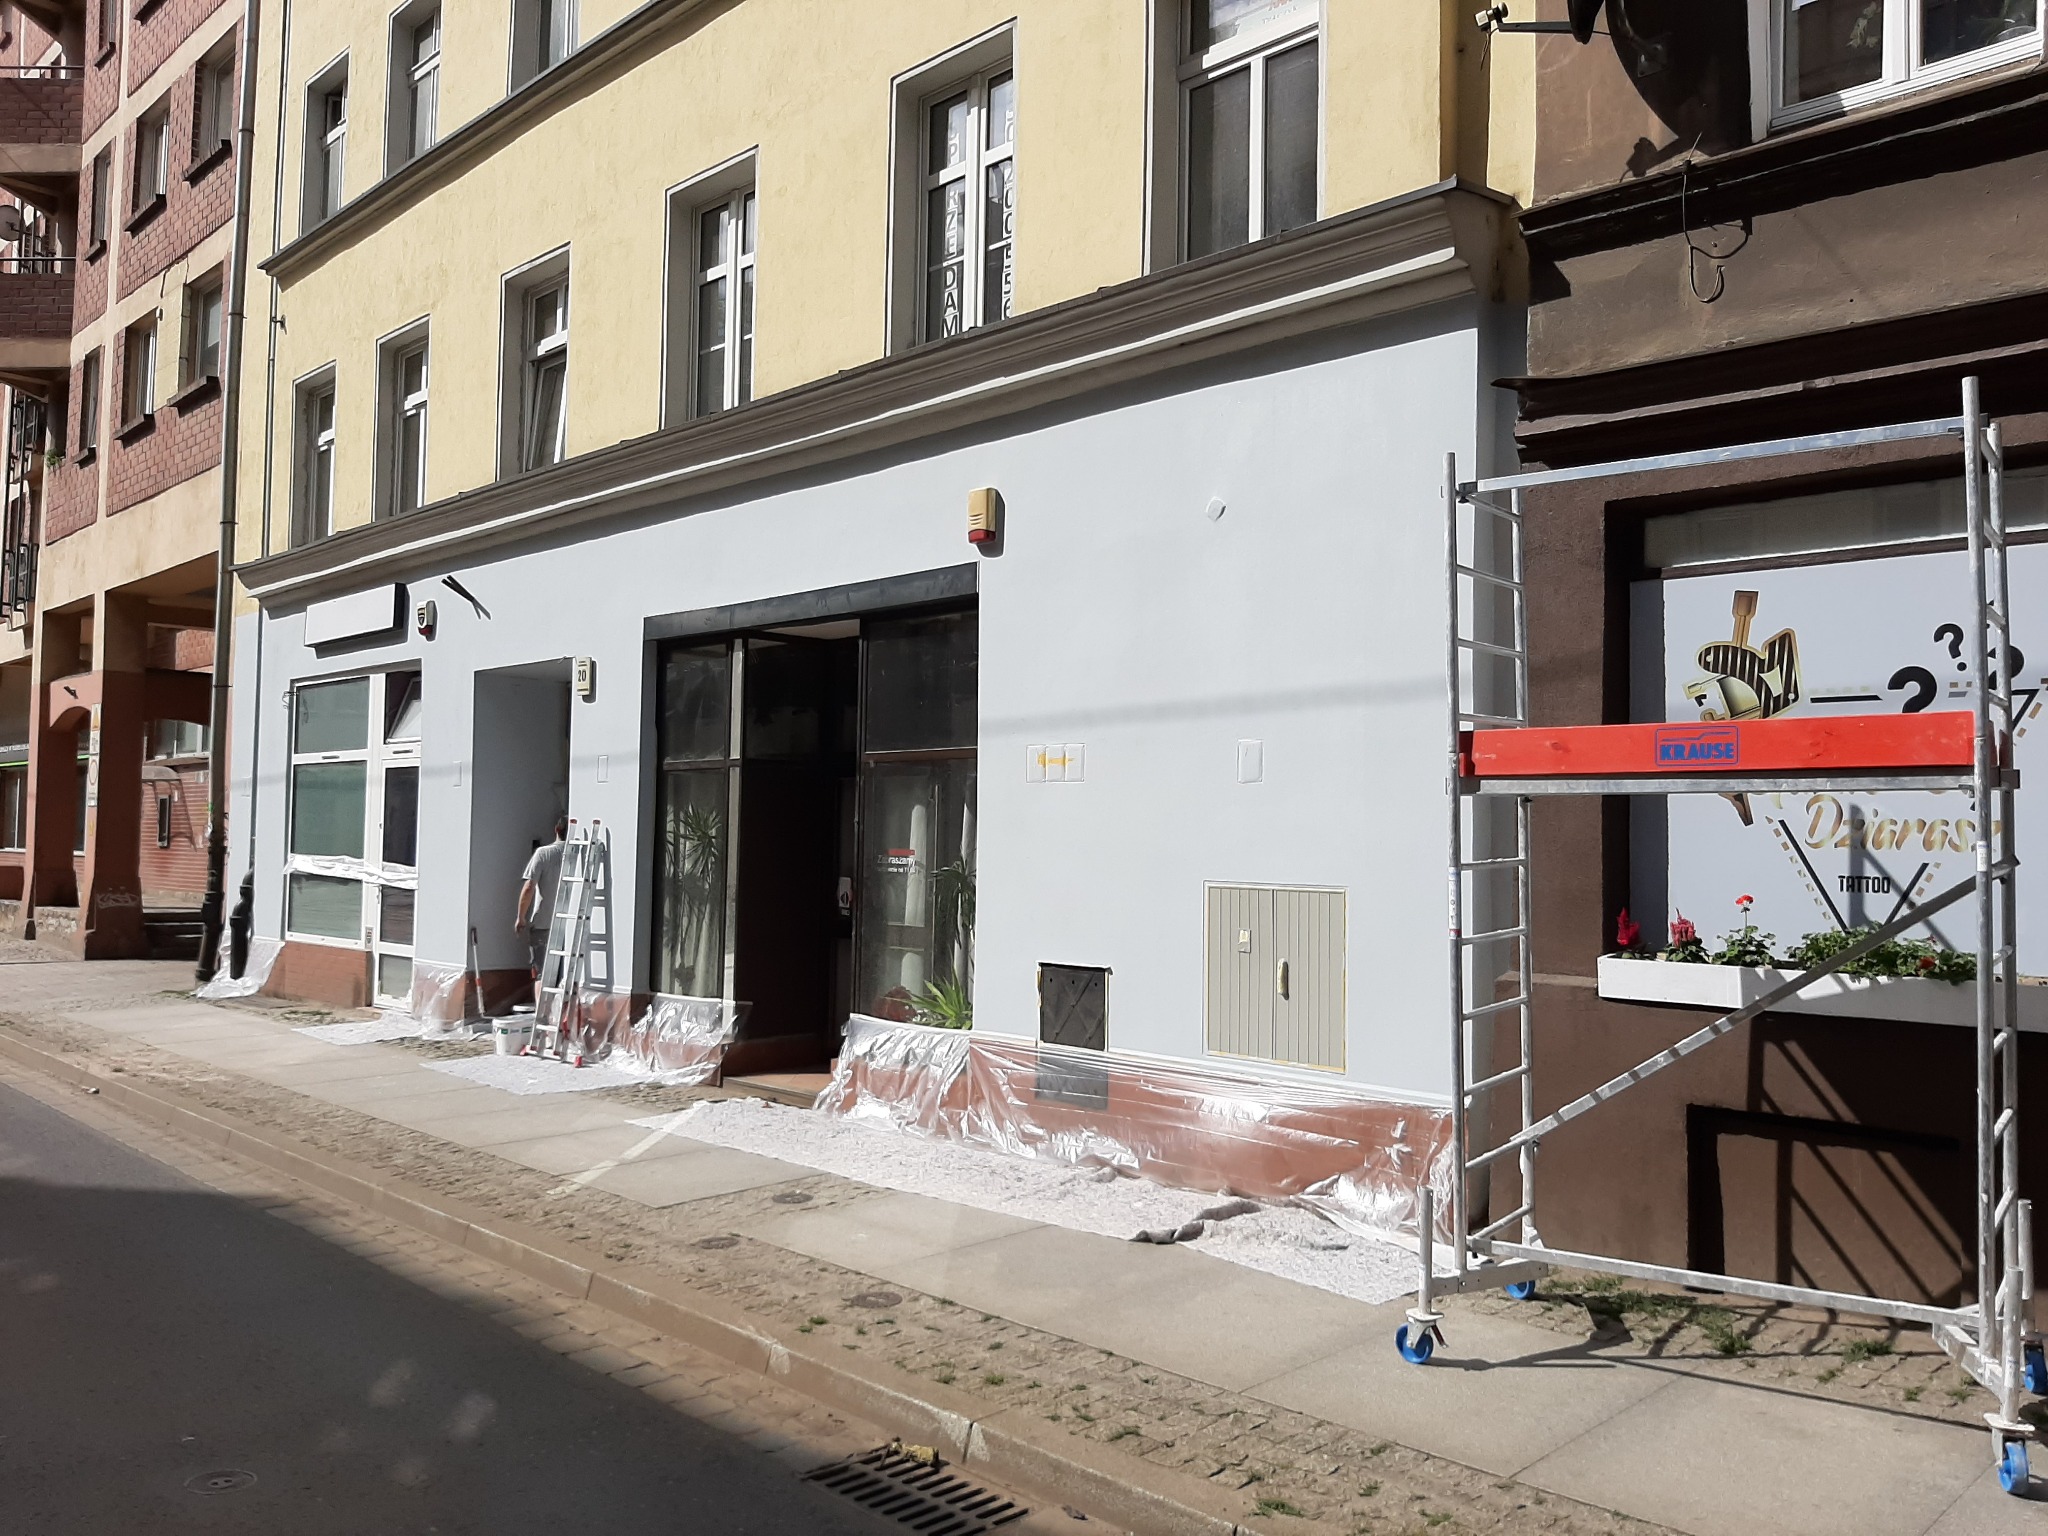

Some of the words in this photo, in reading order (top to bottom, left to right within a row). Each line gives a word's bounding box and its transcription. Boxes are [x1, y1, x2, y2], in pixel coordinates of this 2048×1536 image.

[578, 669, 586, 682] 20
[1660, 743, 1734, 761] KRAUSE
[1838, 875, 1891, 894] TATTOO
